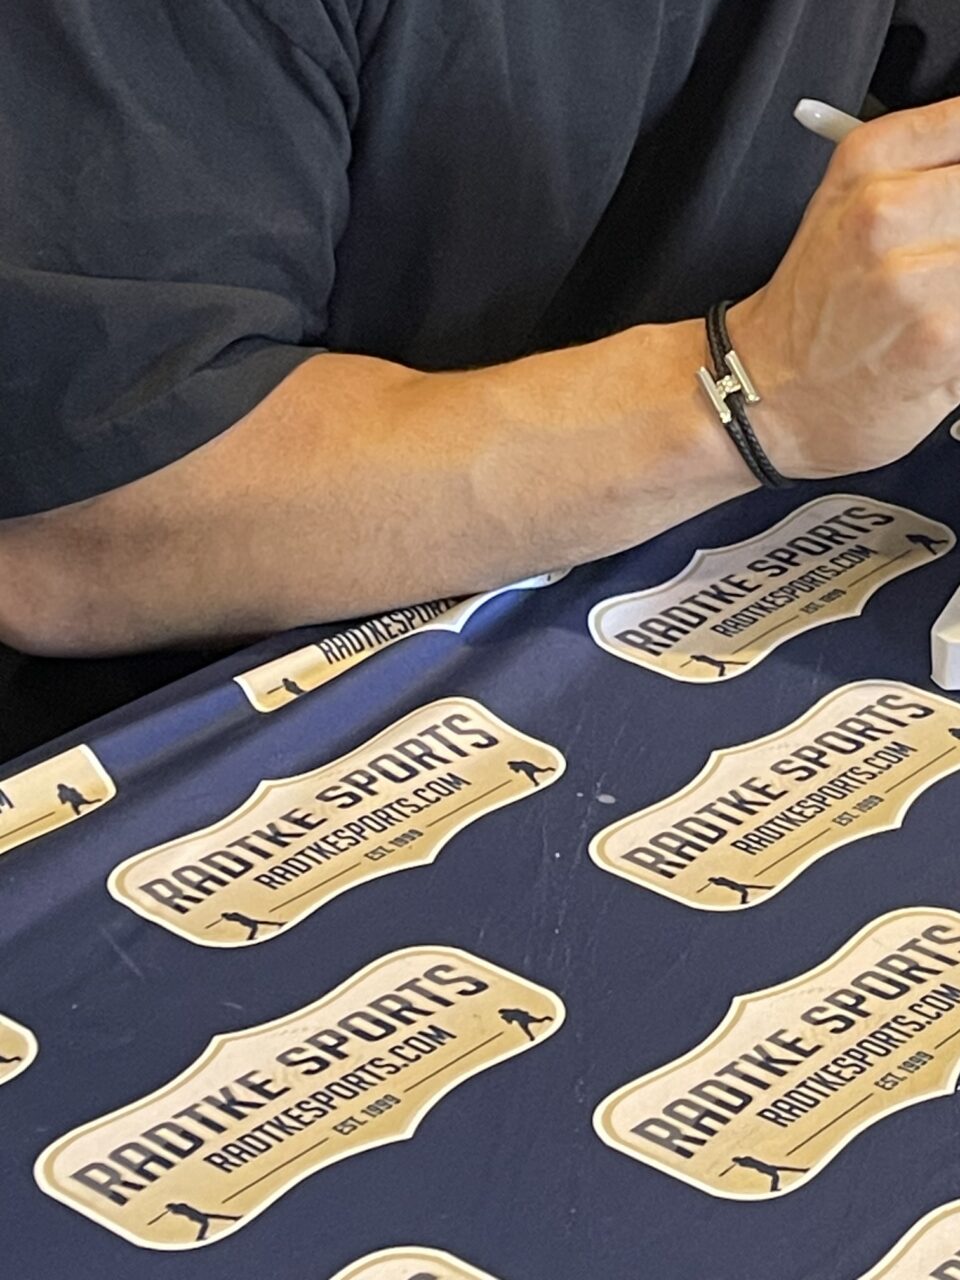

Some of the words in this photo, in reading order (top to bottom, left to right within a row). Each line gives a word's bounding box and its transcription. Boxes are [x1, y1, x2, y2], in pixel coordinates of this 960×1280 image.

[614, 573, 764, 657] RADTKE
[747, 505, 896, 579] SPORTS
[710, 543, 879, 638] RADTKESPORTS.COM
[139, 807, 328, 915] RADTKE
[315, 713, 500, 810] SPORTS
[253, 772, 472, 890] RADTKESPORTS.COM
[621, 776, 789, 880] RADTKE
[770, 693, 936, 783] SPORTS
[730, 741, 918, 855] RADTKESPORTS.COM
[69, 1068, 291, 1207] RADTKE
[275, 963, 490, 1076] SPORTS
[203, 1024, 457, 1173] RADTKESPORTS.COM
[631, 1027, 822, 1160] RADTKE
